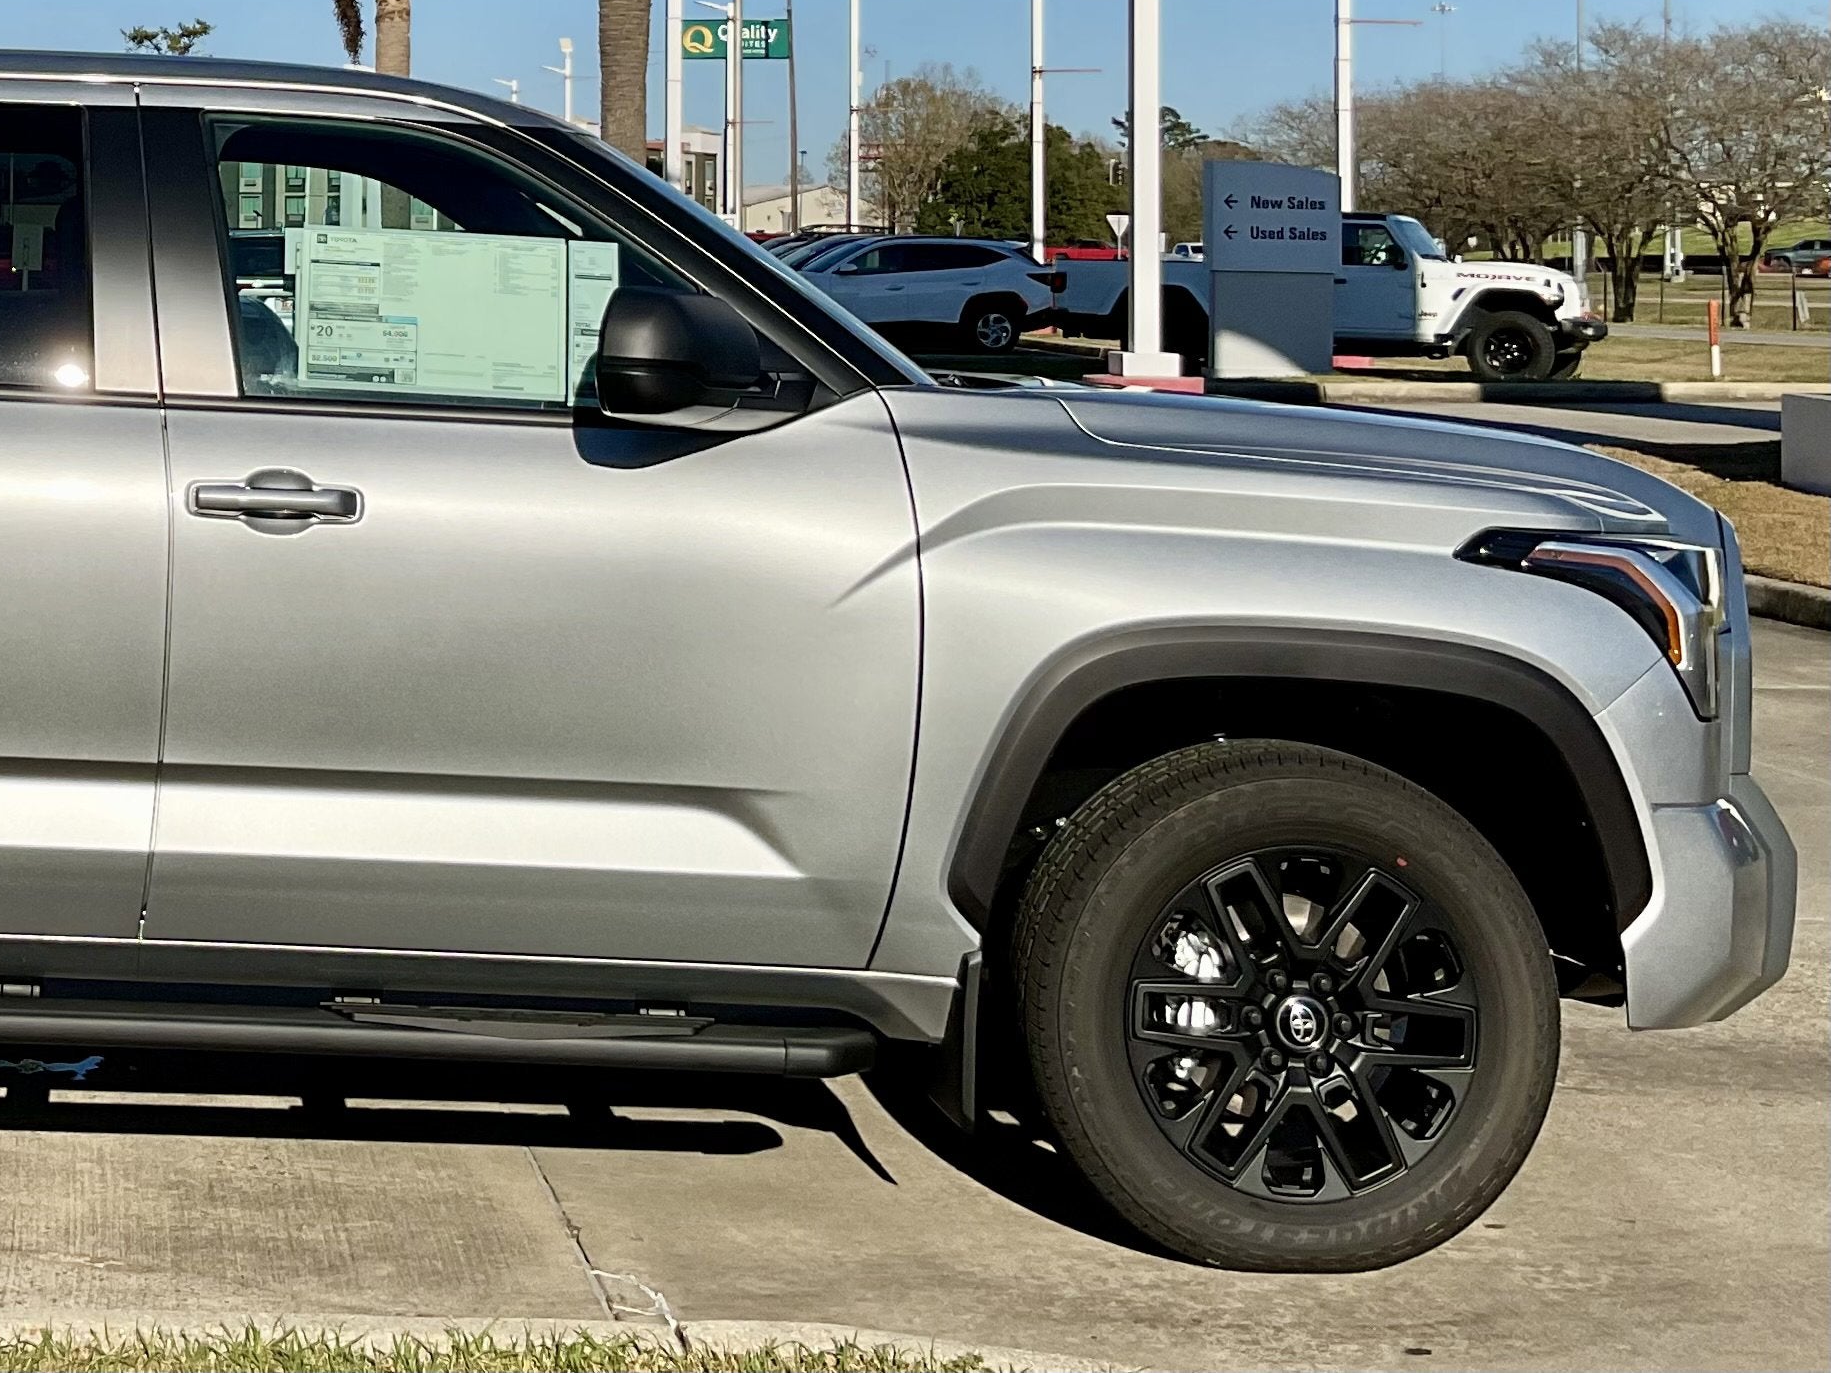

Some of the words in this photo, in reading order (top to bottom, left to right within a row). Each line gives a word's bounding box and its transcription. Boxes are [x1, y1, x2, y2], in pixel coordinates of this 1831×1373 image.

[717, 24, 778, 43] Qality
[1250, 195, 1283, 210] New
[1287, 196, 1326, 210] Sales
[1250, 226, 1285, 240] Used
[1288, 227, 1327, 241] Sales
[1456, 272, 1537, 282] MOJAVE
[316, 325, 333, 337] 20
